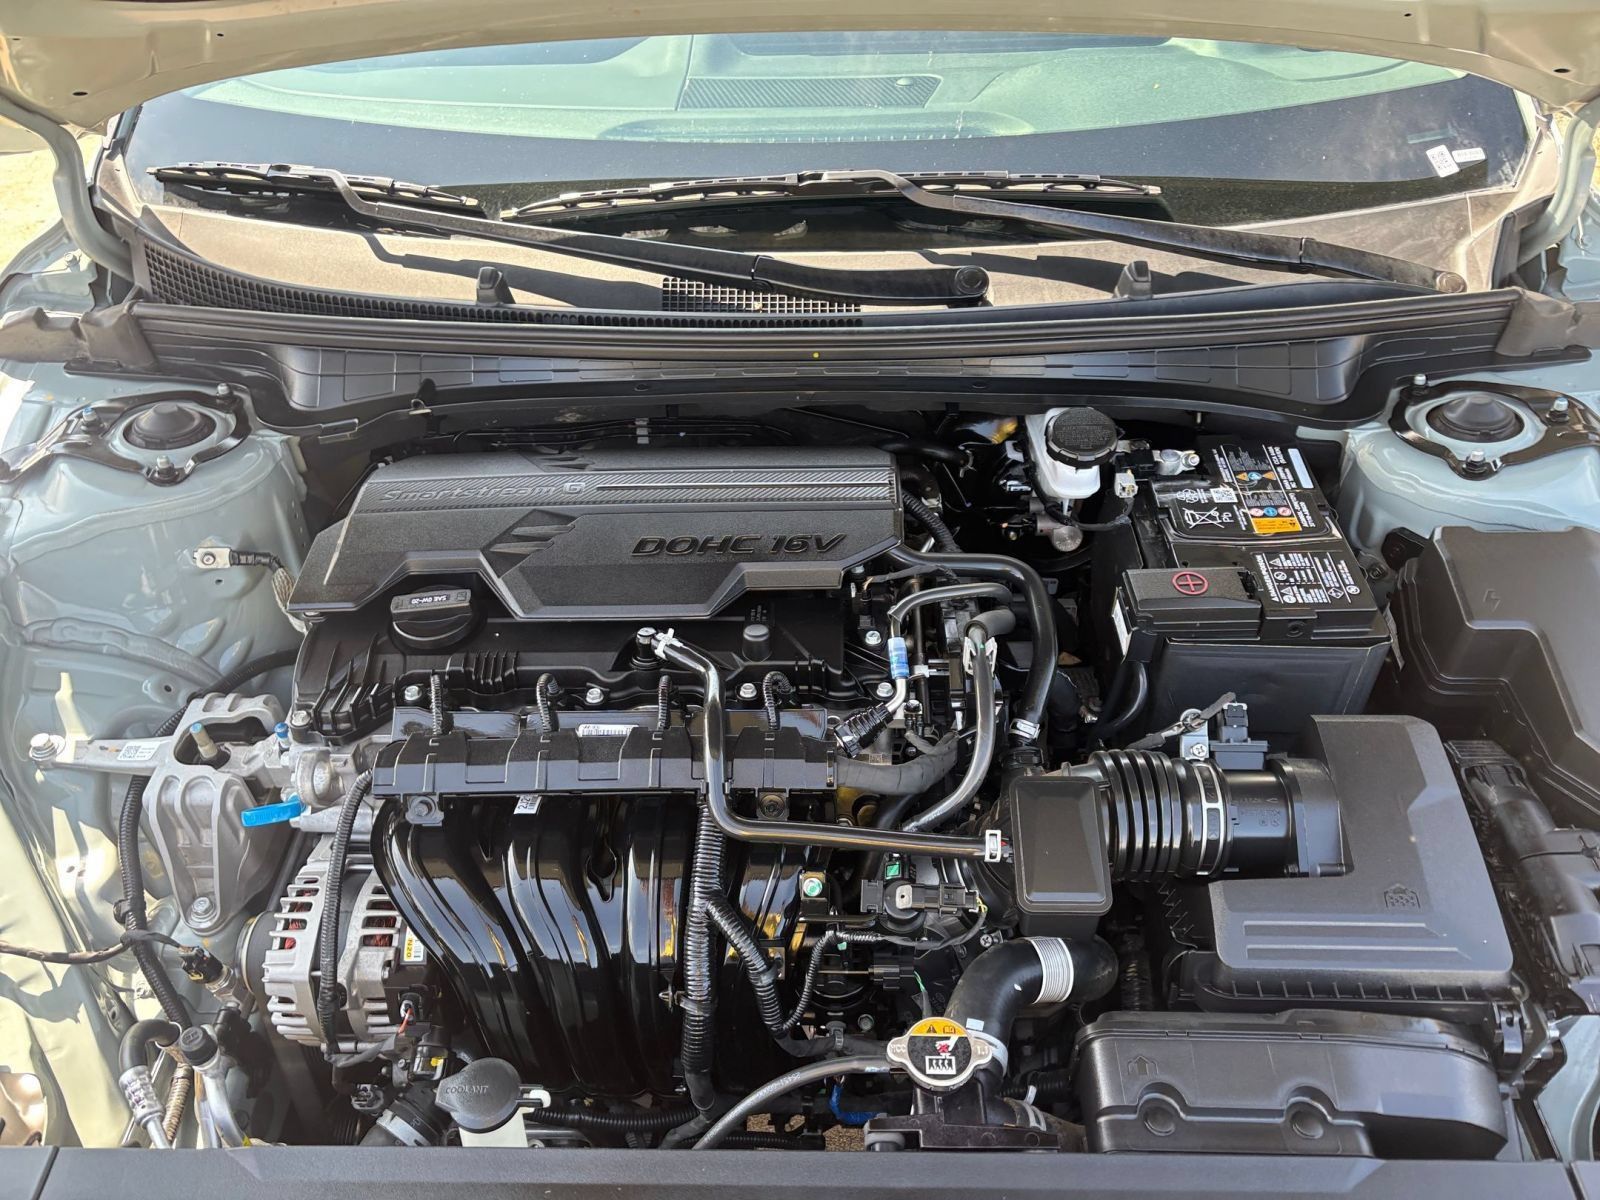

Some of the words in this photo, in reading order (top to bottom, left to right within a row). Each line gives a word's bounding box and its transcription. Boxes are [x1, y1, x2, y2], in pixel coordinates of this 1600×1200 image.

[379, 486, 557, 501] Smartstream
[1222, 511, 1234, 522] Pb
[631, 533, 762, 556] DOHC
[768, 533, 847, 554] 16V
[446, 1086, 488, 1094] COOLANT
